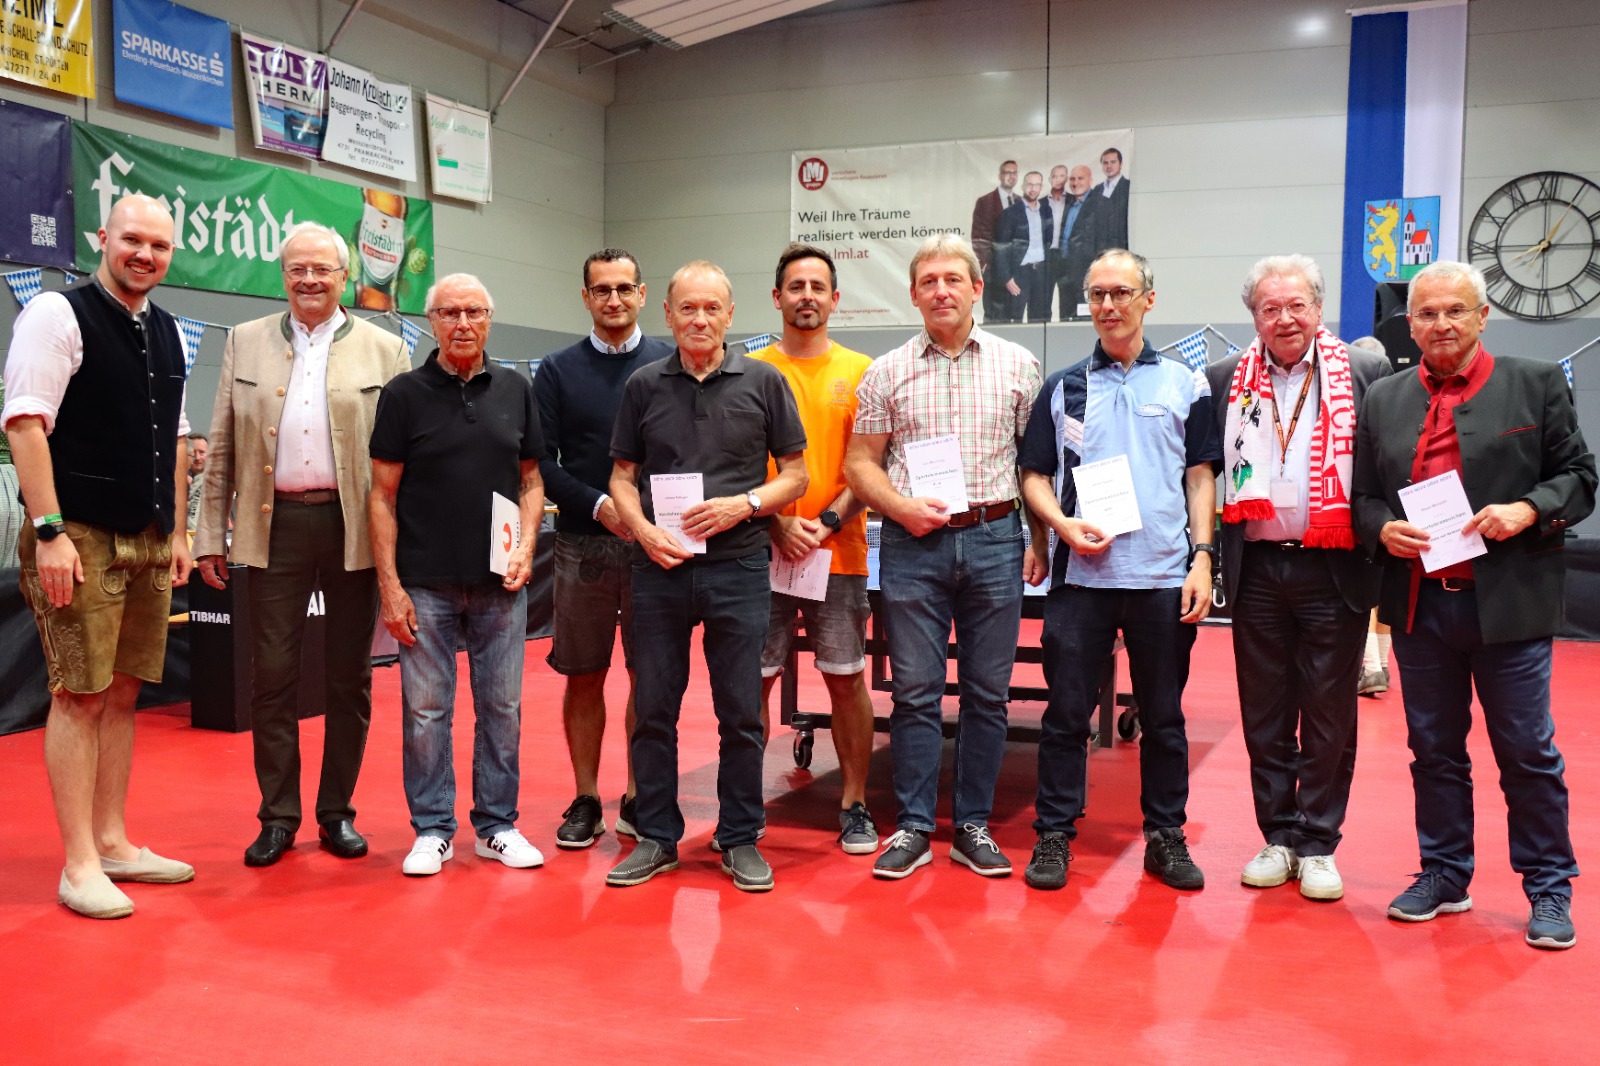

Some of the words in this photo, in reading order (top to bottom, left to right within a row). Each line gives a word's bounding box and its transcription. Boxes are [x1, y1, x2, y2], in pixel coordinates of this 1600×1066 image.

[8, 21, 88, 57] SCHALL-BRNDSCHUTZ
[121, 30, 209, 73] SPARKASSE
[329, 68, 361, 95] Johann
[330, 97, 373, 122] Baggerungen
[356, 123, 387, 145] Recycling
[798, 211, 827, 224] Weil
[832, 210, 857, 223] Ihre
[859, 208, 911, 221] Träume
[797, 229, 854, 242] realisiert
[858, 227, 907, 240] werden
[1318, 342, 1355, 460] REICH
[190, 610, 231, 625] TIBHAR
